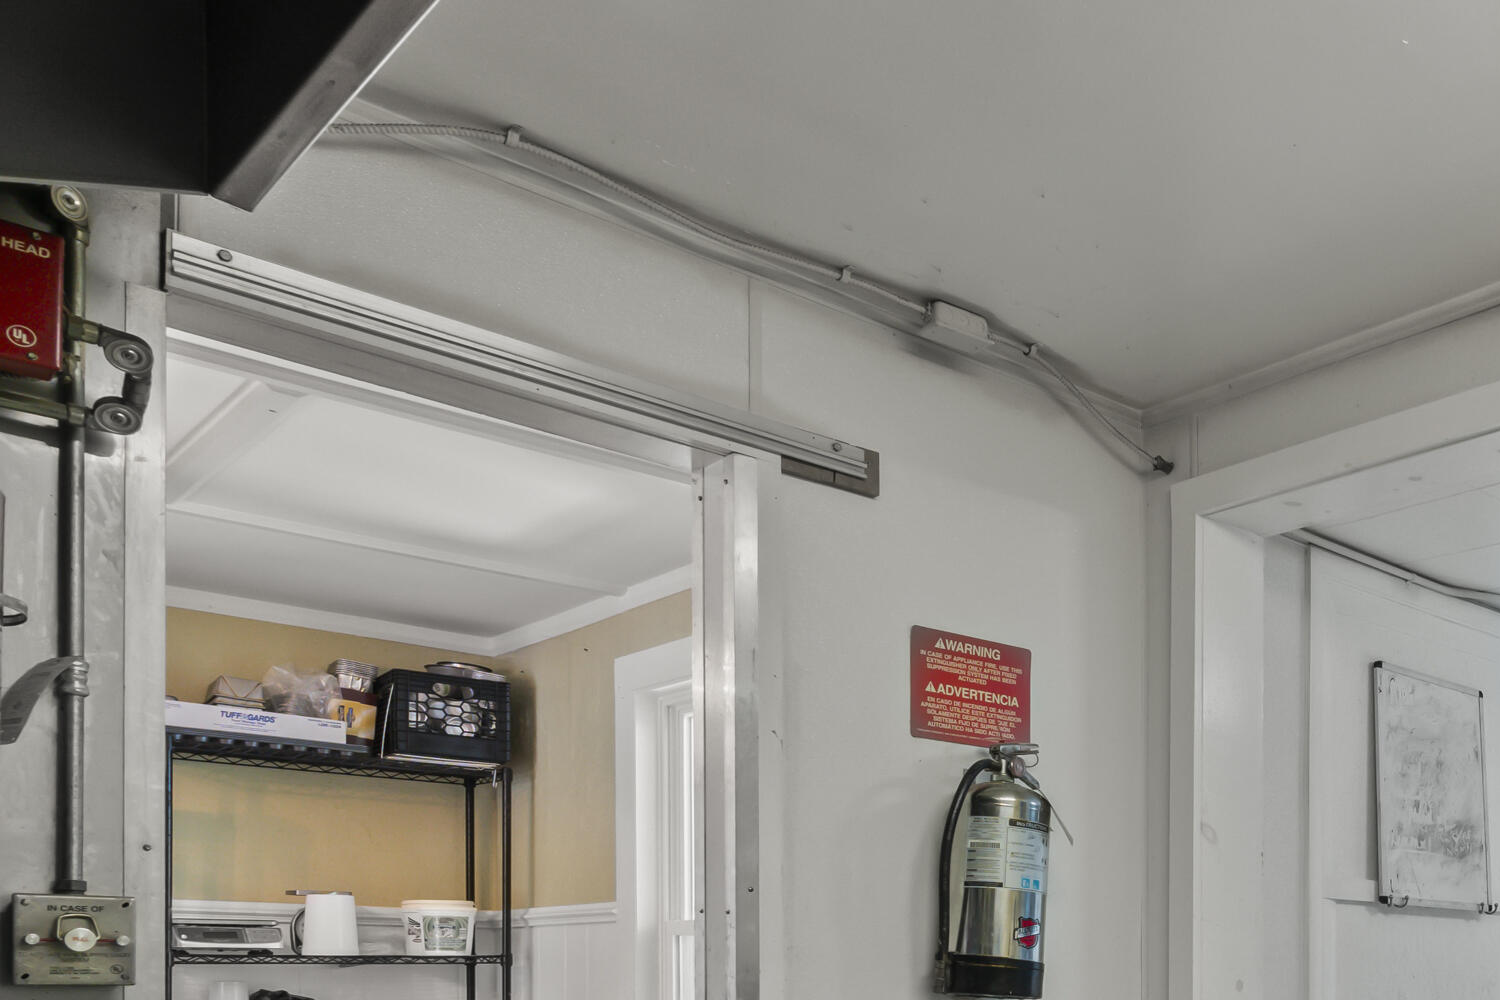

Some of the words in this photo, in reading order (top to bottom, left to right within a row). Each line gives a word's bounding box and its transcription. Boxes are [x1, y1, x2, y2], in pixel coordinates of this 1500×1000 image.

[1, 236, 51, 258] HEAD
[13, 328, 30, 345] UL
[945, 639, 1001, 661] WARNING
[937, 683, 1020, 708] ADVERTENCIA
